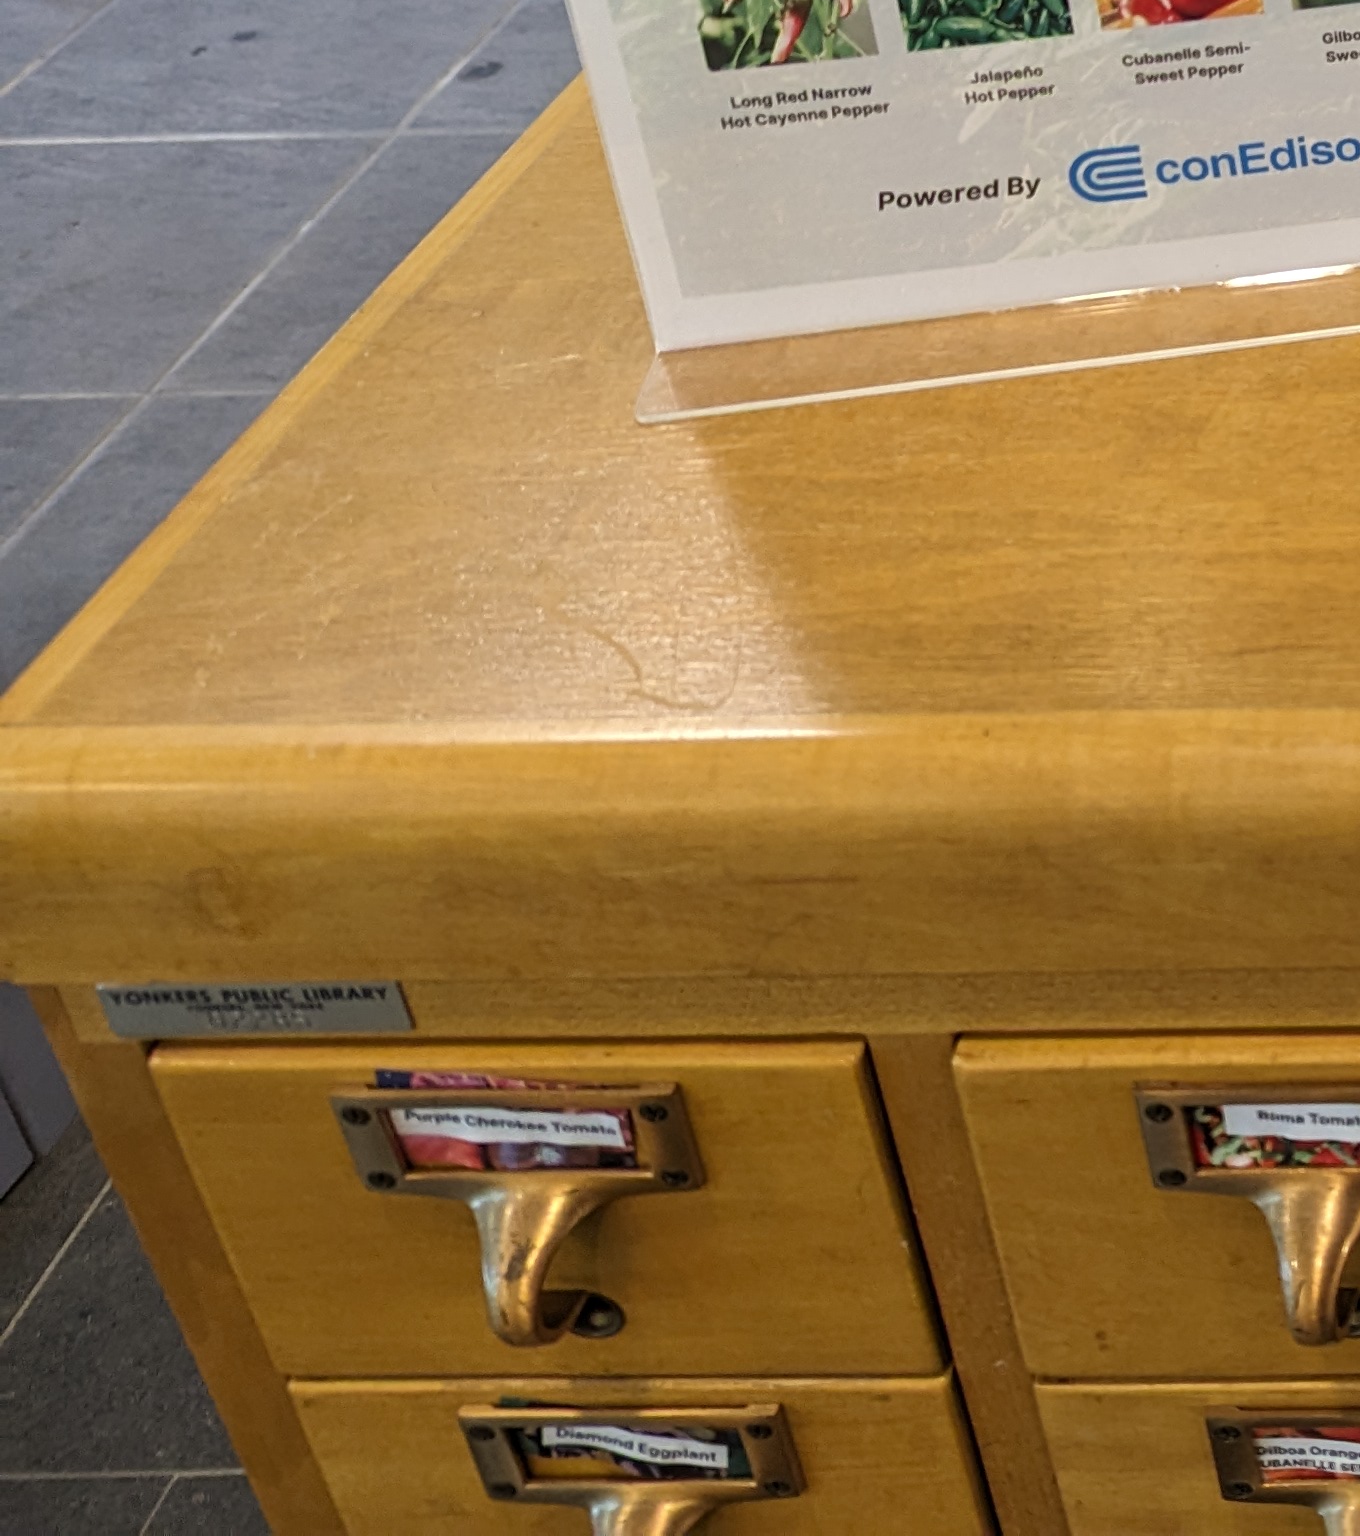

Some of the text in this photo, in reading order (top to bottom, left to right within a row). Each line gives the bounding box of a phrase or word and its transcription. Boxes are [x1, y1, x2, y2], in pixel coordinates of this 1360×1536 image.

[1121, 41, 1251, 68] Cubanelle Semi-
[970, 65, 1044, 85] Jalapeño
[1134, 63, 1245, 85] Sweet Pepper
[729, 85, 872, 110] Long Red Narrow
[964, 84, 1056, 105] Hot Pepper
[720, 103, 890, 130] Hot Cayenne Pepper
[878, 176, 1041, 211] Powered By
[110, 986, 388, 1006] YONKERS PUBLIC LIBRARY
